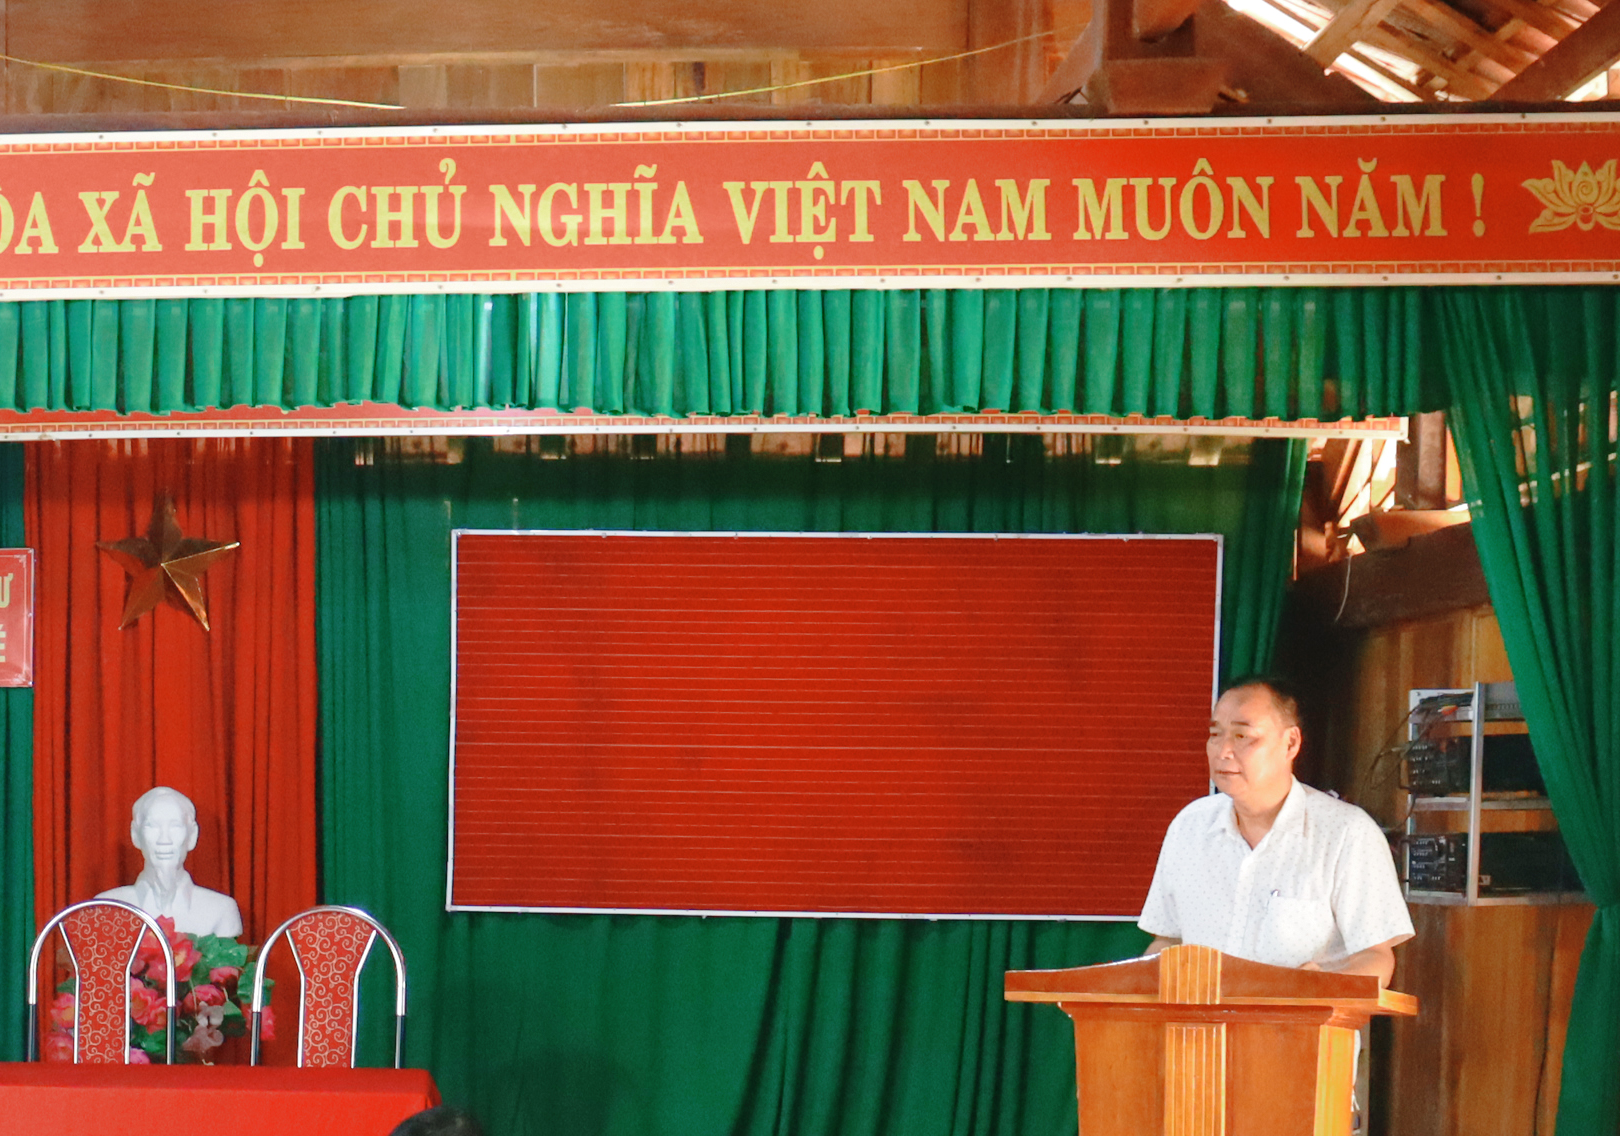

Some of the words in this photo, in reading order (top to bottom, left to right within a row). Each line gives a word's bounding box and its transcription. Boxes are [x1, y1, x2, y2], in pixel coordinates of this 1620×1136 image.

[76, 171, 163, 252] XÃ
[184, 169, 306, 268] HỘI
[326, 157, 467, 250] CHỦ
[489, 164, 704, 247] NGHĨA
[723, 161, 882, 260] VIỆT
[902, 178, 1052, 242] NAM
[1072, 158, 1273, 240] MUÔN
[1295, 156, 1449, 239] NĂM
